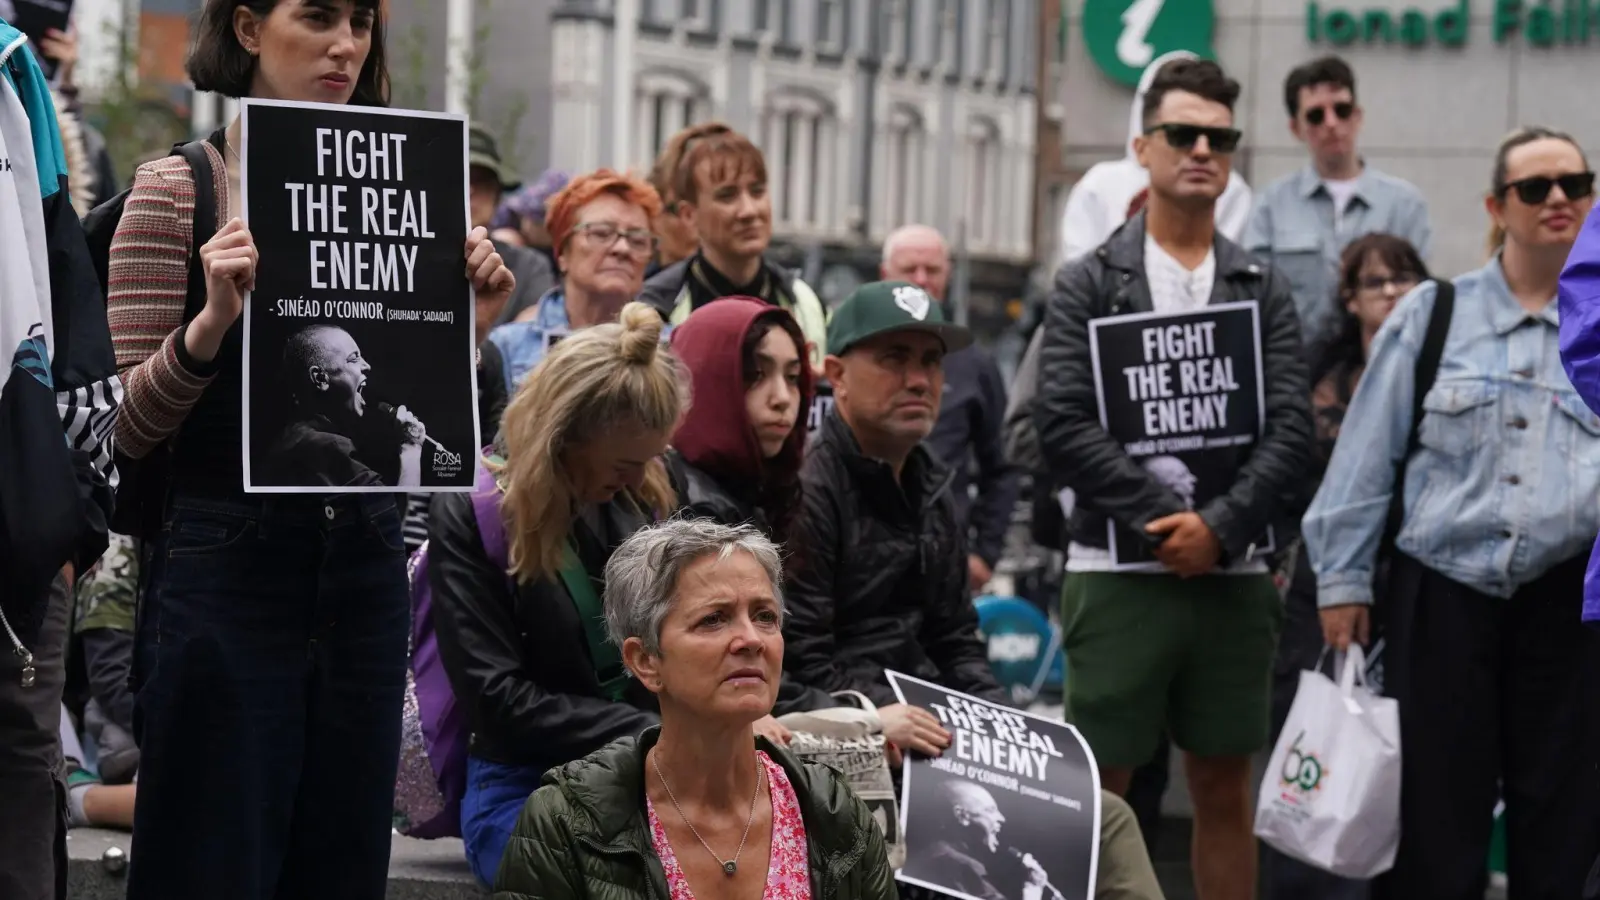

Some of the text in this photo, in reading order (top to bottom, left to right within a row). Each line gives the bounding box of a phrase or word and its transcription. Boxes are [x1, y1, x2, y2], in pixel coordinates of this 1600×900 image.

[1307, 0, 1469, 44] Ionad
[316, 127, 407, 181] FIGHT
[285, 182, 436, 239] THE REAL
[310, 239, 419, 293] ENEMY
[277, 296, 321, 317] SINÉAD
[324, 300, 384, 320] O'CONNOR
[1142, 321, 1217, 363] FIGHT
[1122, 356, 1240, 402] THE REAL
[1143, 393, 1229, 437] ENEMY
[433, 452, 462, 465] ROSA
[929, 702, 1064, 759] THE REAL
[945, 694, 1029, 733] FIGHT
[955, 727, 1050, 782] ENEMY
